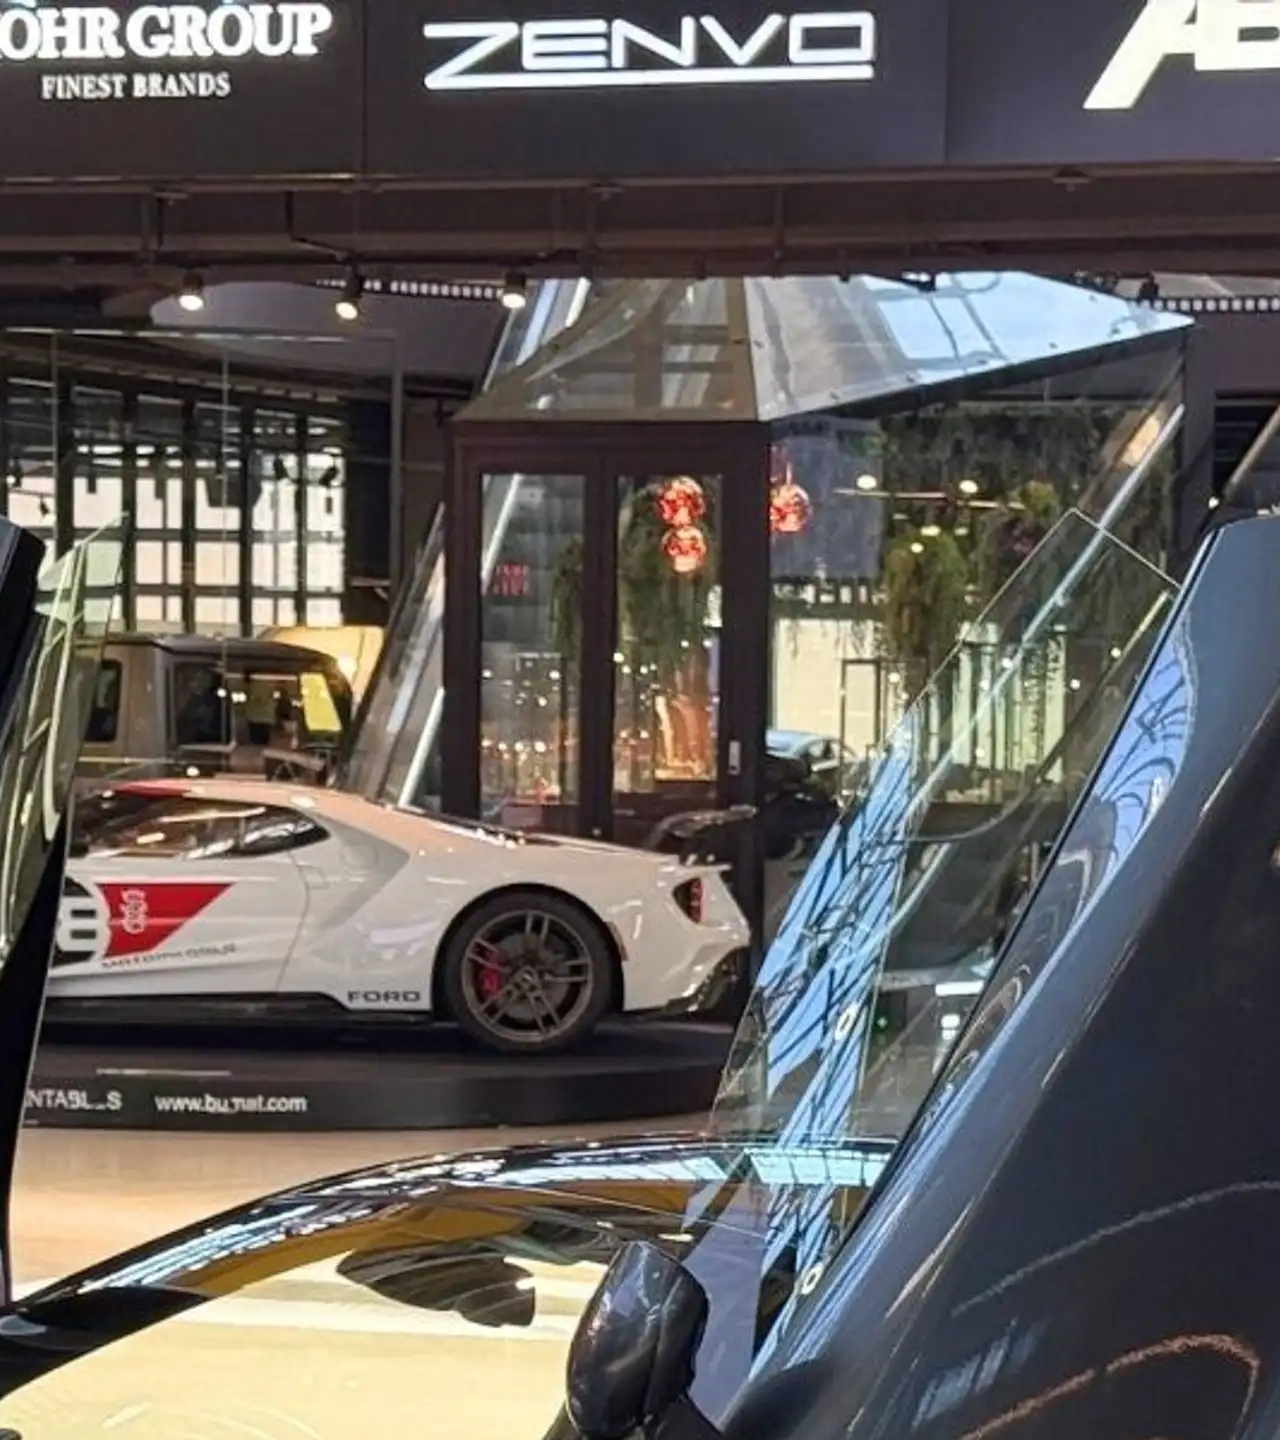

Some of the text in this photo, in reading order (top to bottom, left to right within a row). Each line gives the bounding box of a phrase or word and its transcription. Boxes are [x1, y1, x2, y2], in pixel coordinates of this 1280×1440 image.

[126, 3, 333, 58] GROUP
[423, 12, 876, 89] ZENVO
[41, 71, 231, 99] FINEST BRANDS
[347, 990, 421, 1004] FORD
[23, 1089, 122, 1110] NTABLS
